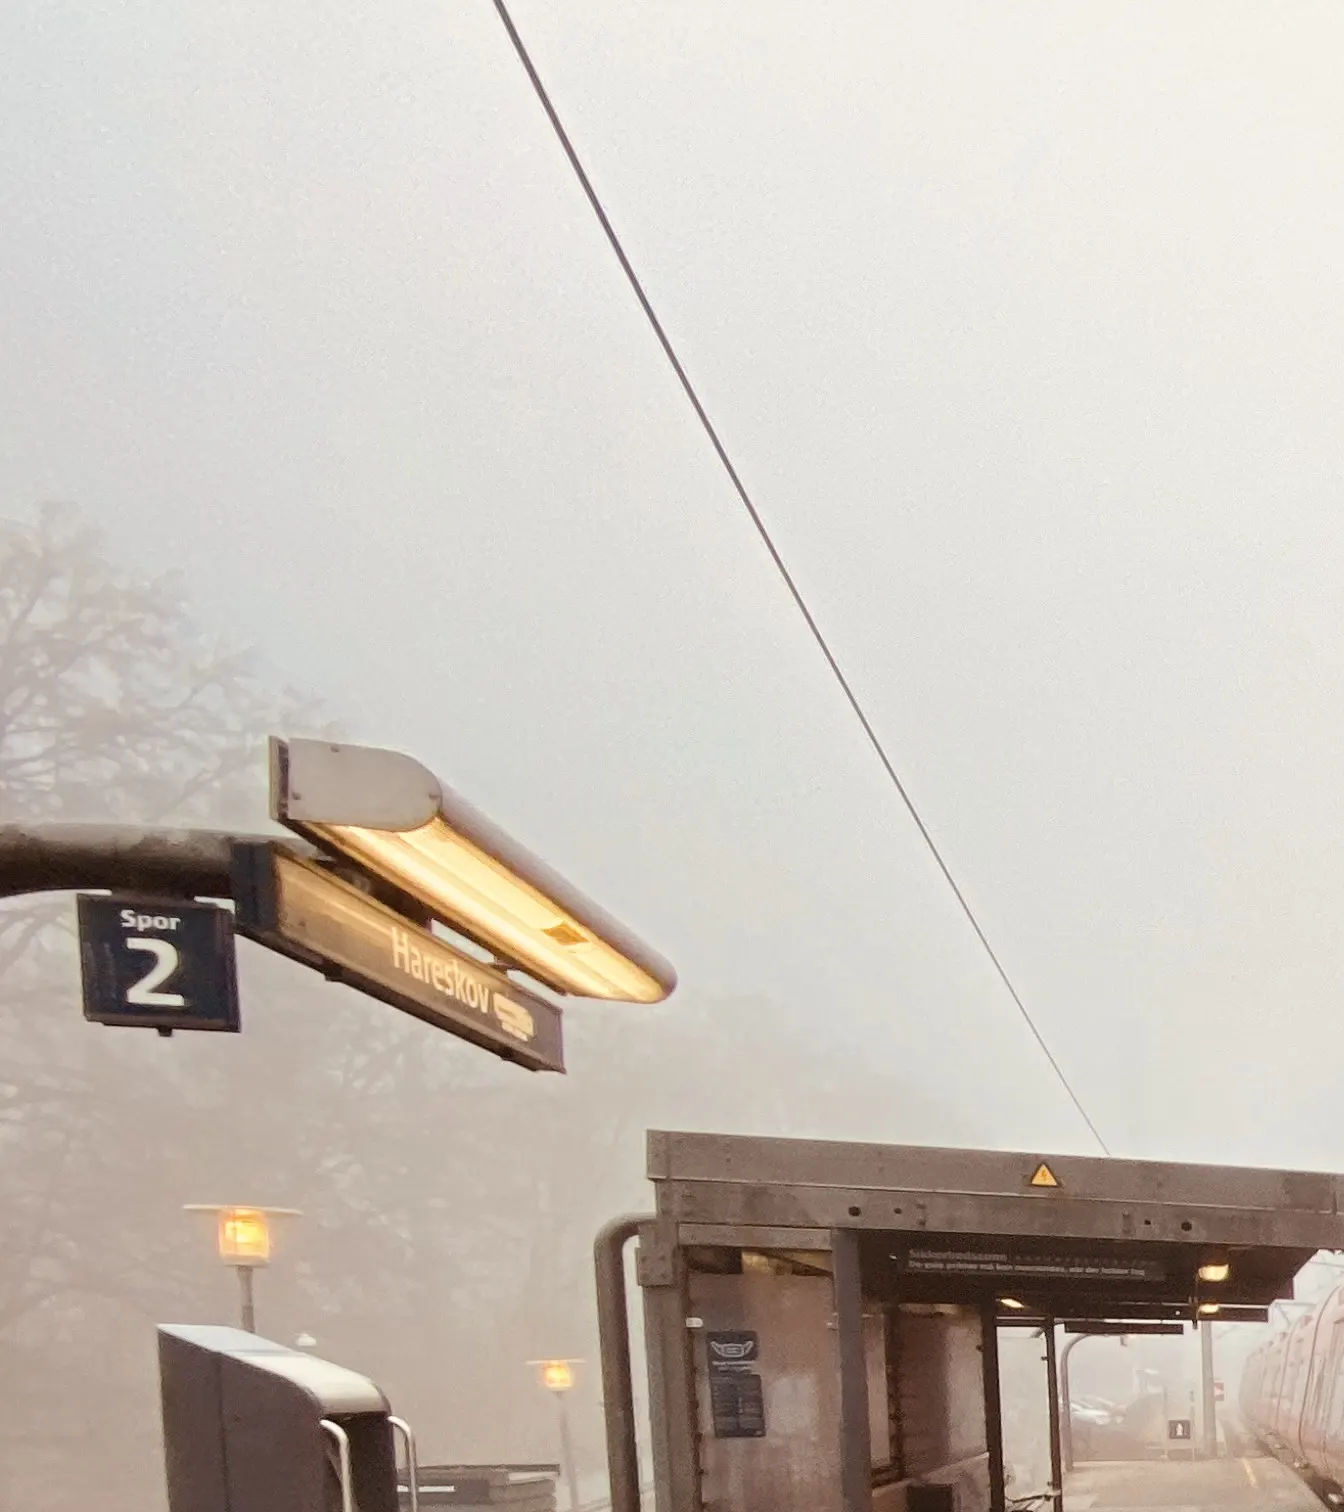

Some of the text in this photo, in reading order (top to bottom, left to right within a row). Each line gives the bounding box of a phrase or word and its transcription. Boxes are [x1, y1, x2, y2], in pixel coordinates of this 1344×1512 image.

[120, 909, 181, 932] Spor
[126, 937, 185, 1006] 2
[392, 926, 489, 1014] Hareskov
